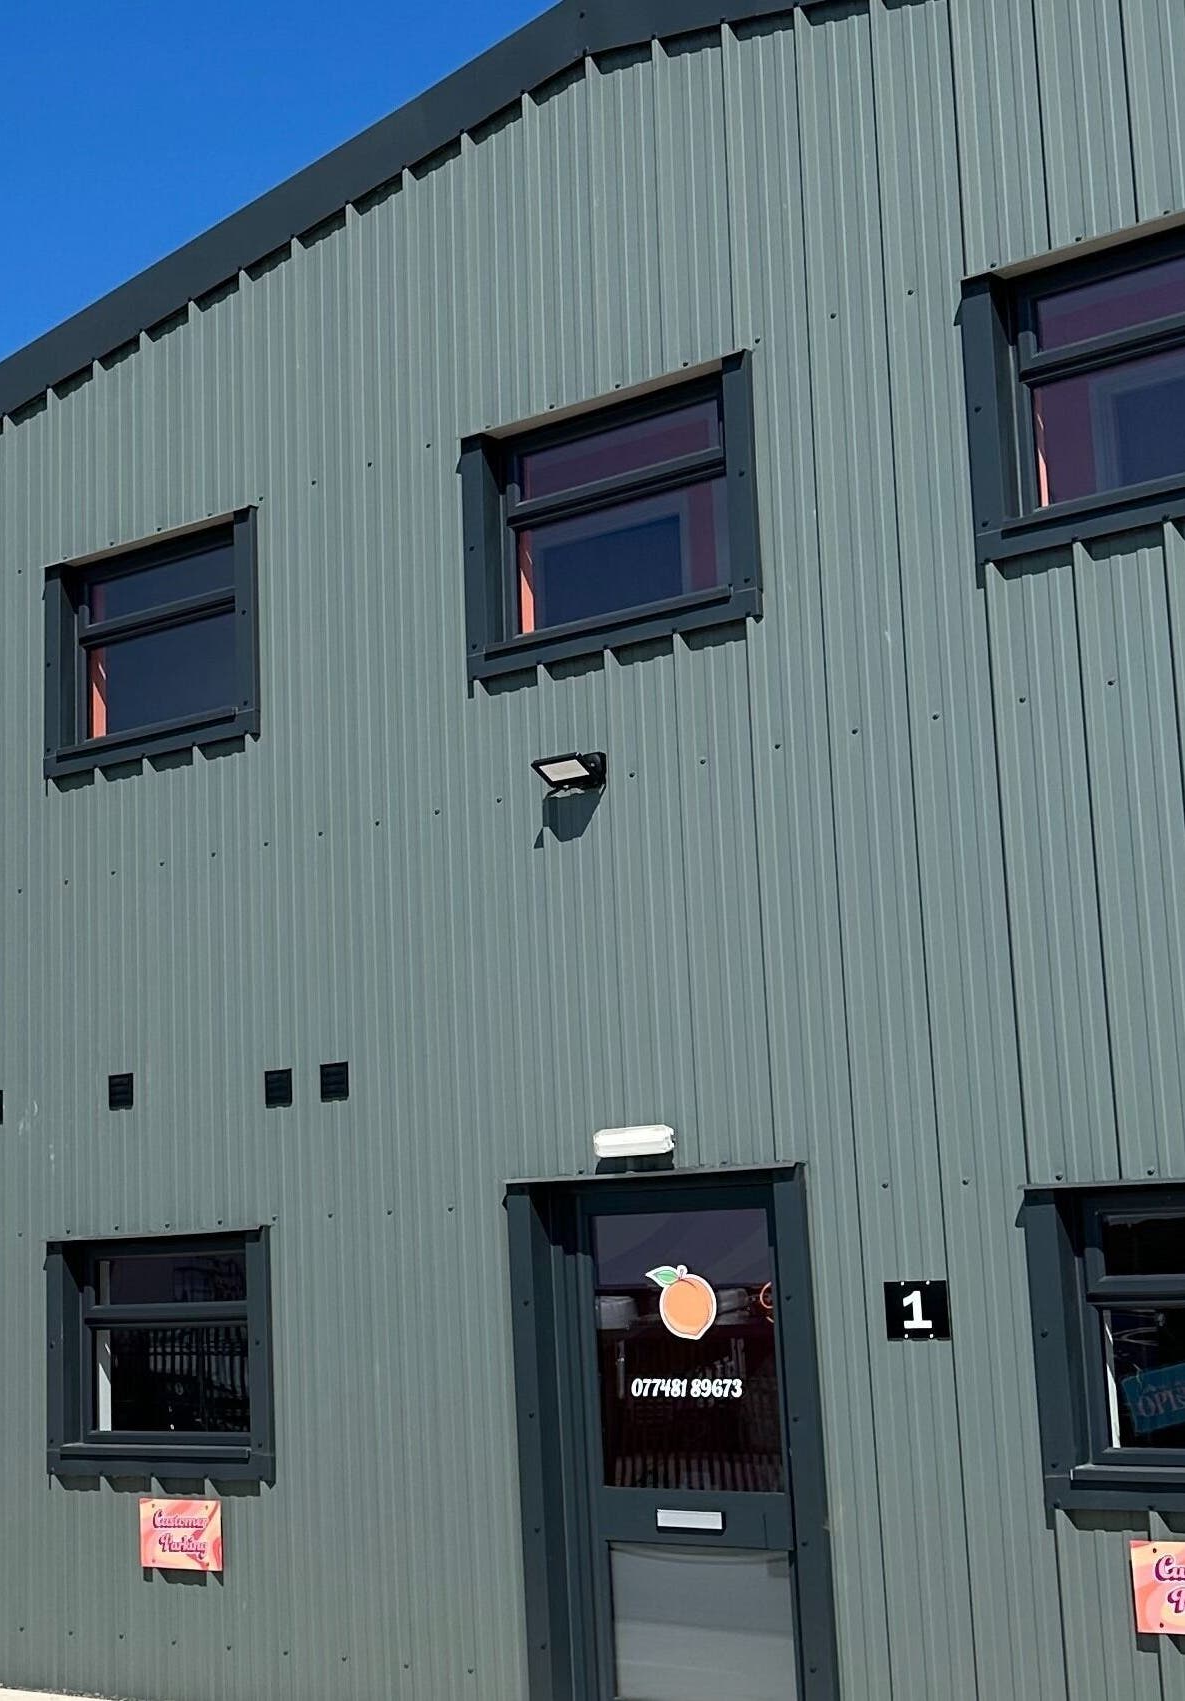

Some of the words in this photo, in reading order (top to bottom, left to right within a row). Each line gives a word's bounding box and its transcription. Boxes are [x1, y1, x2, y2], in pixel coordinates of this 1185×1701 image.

[902, 1290, 933, 1330] 1
[631, 1378, 688, 1397] 077481
[690, 1378, 743, 1398] 89673
[153, 1509, 208, 1528] Customer
[159, 1533, 207, 1559] Parking
